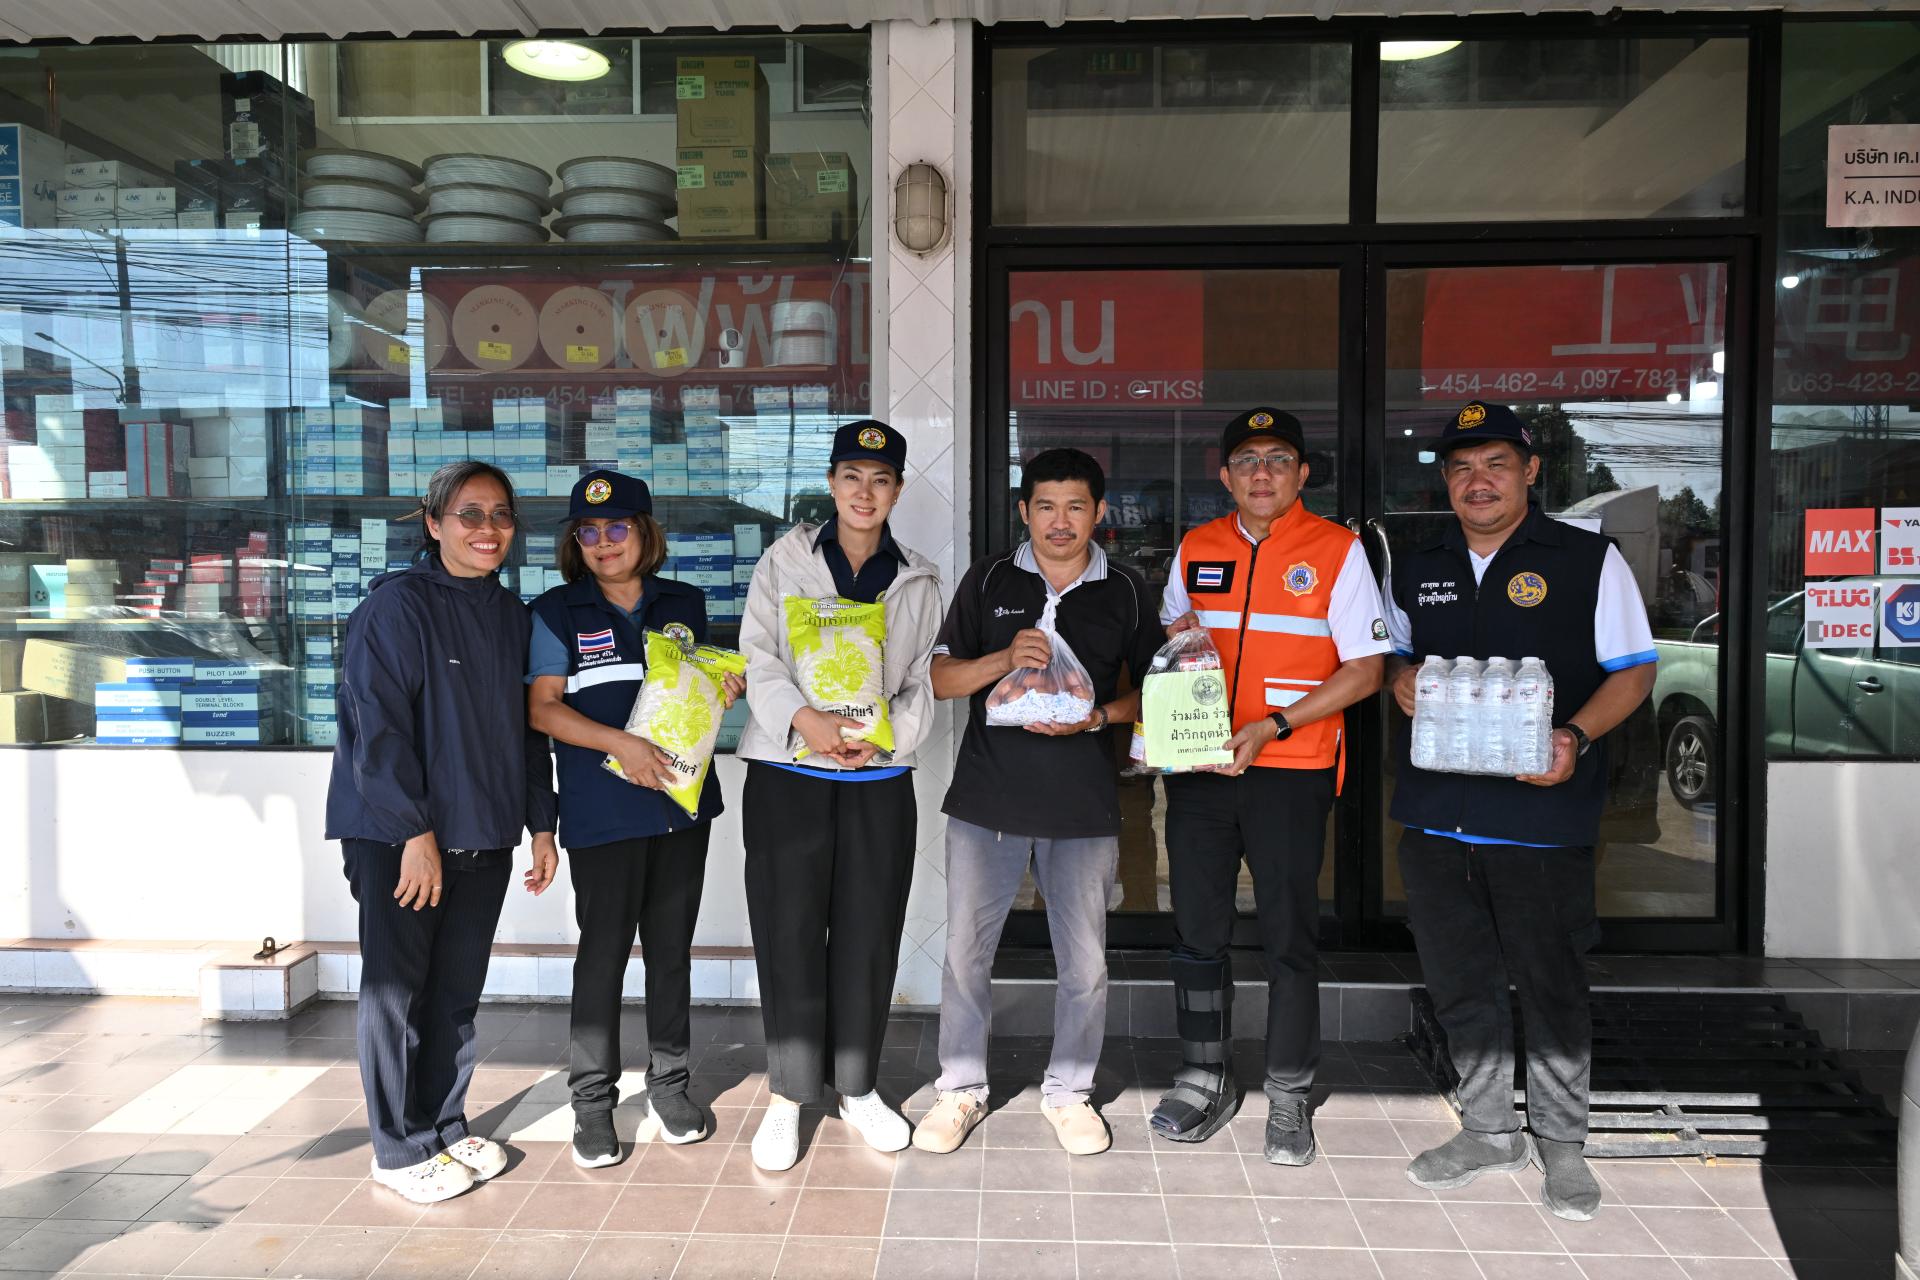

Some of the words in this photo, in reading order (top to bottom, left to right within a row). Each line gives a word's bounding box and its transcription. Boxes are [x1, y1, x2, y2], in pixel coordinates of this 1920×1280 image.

[1844, 148, 1888, 164] บริษัท
[1845, 190, 1880, 204] K.A.
[1021, 381, 1075, 400] LINE
[1082, 381, 1108, 400] ID
[1810, 530, 1872, 553] MAX
[1824, 624, 1872, 638] IDEC
[1170, 708, 1208, 722] ร่วมมือ
